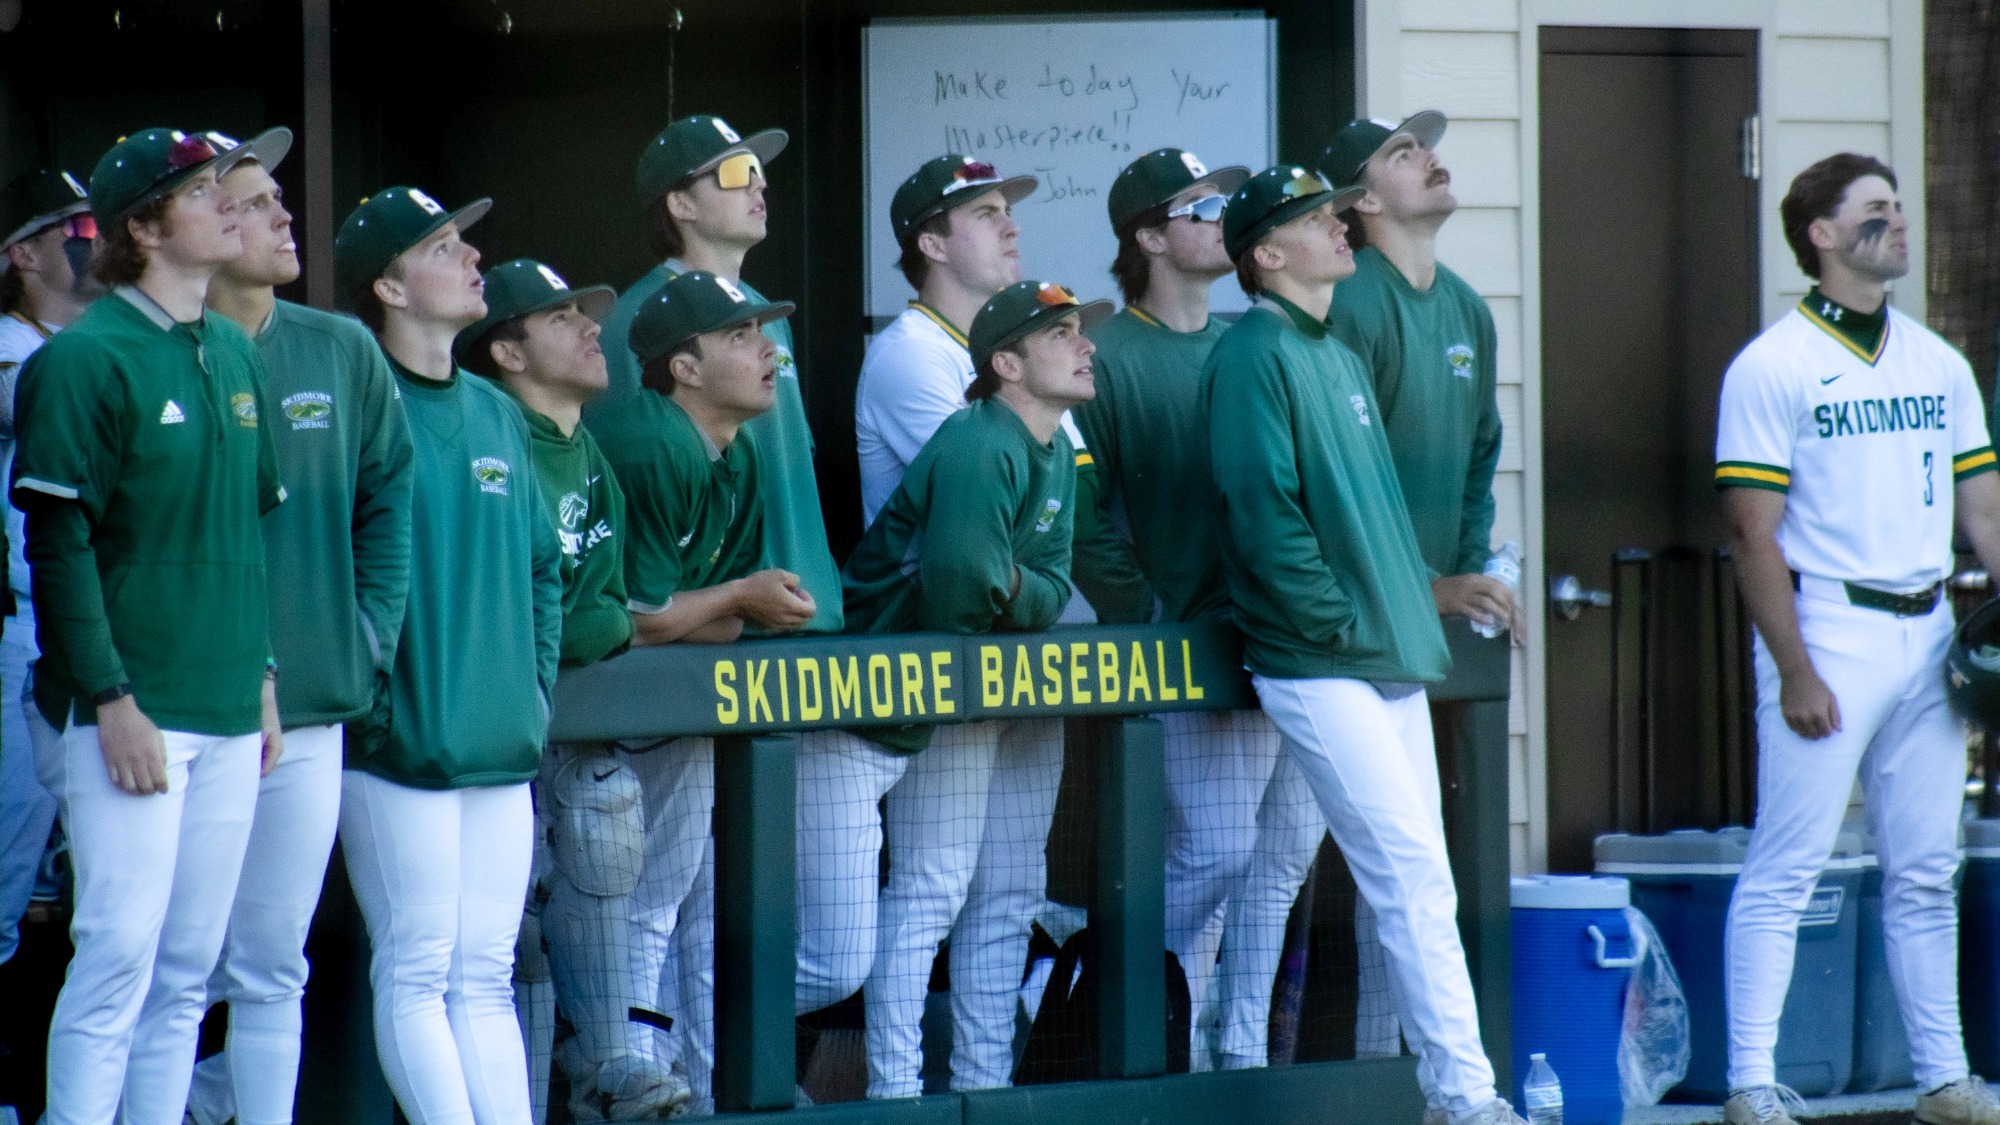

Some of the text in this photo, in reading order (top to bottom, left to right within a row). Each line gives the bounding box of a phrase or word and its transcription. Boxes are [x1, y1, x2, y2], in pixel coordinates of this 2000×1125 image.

[933, 69, 1009, 107] Make
[1037, 64, 1139, 112] today
[1033, 166, 1097, 204] John
[281, 391, 333, 409] SKIDMORE
[1813, 395, 1946, 439] SKIDMORE
[292, 420, 330, 431] BASEBALL
[1923, 451, 1934, 507] 3
[713, 639, 1205, 725] SKIDMORE BASEBALL
